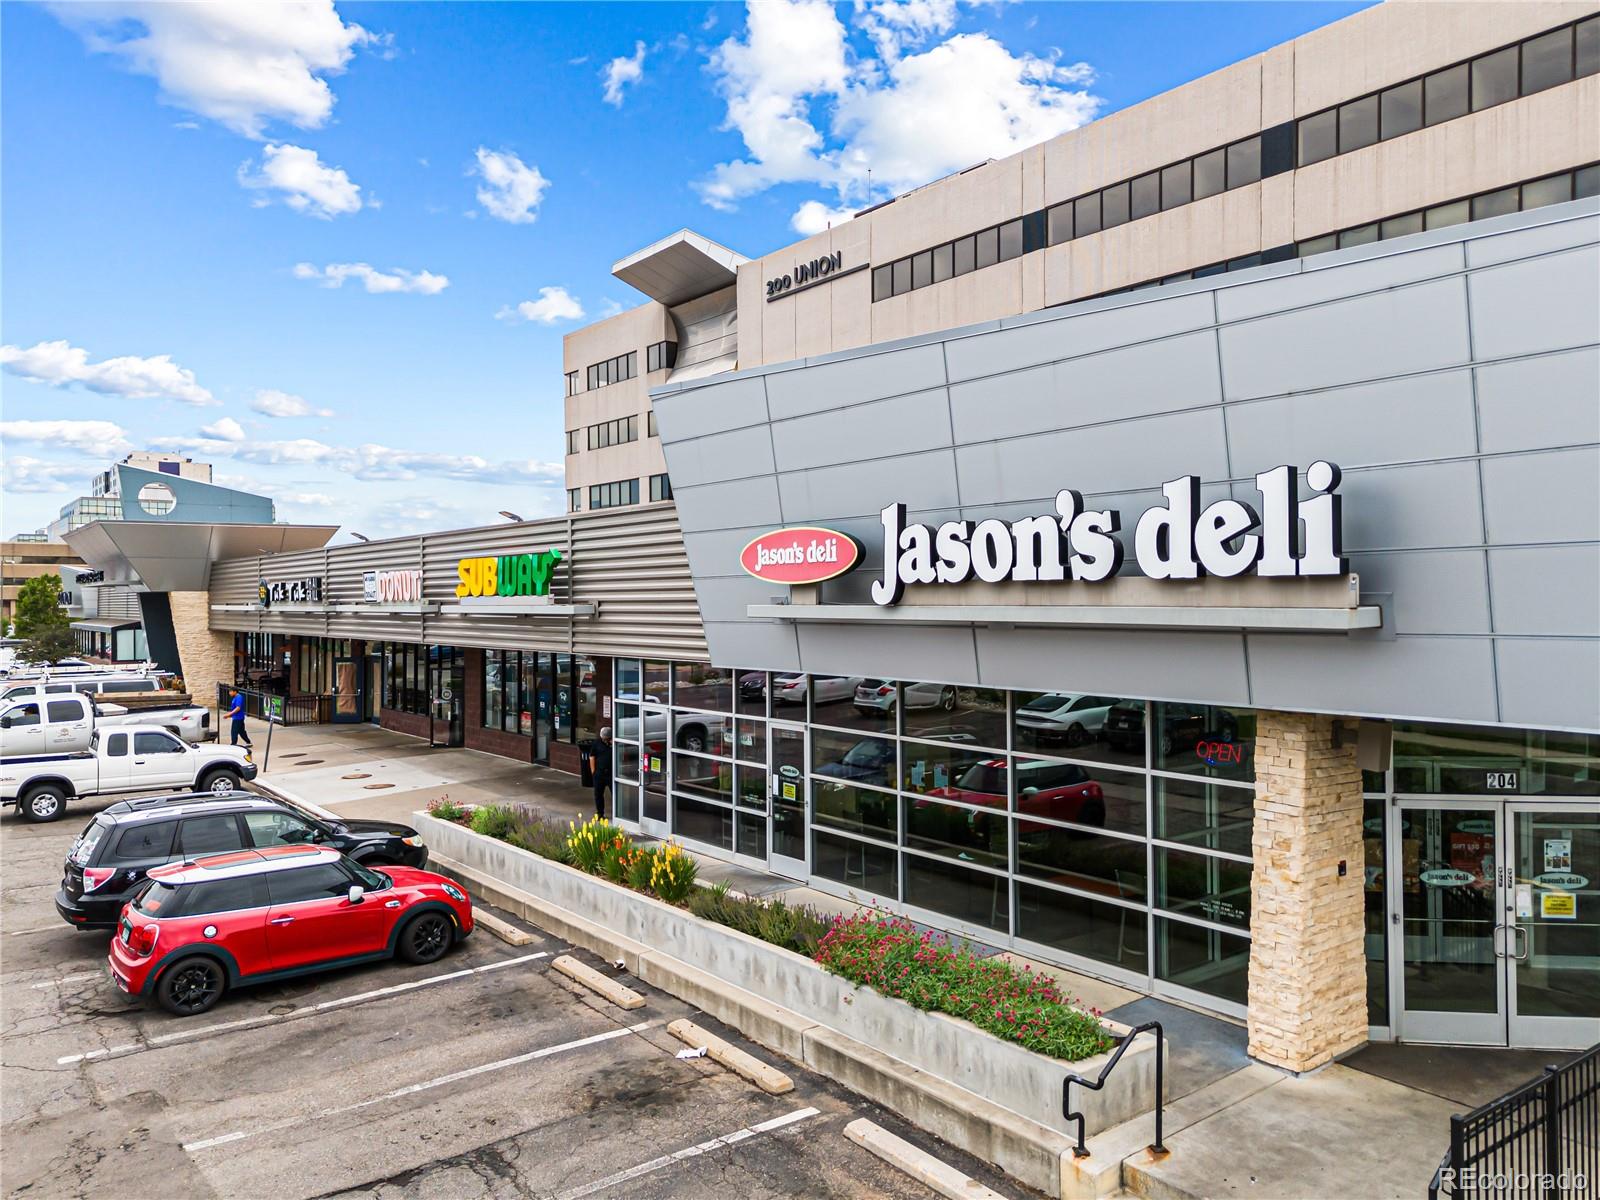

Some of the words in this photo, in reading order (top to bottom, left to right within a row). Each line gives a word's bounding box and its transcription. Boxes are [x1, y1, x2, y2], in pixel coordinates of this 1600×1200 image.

[766, 275, 792, 295] 200
[794, 250, 842, 283] UNION
[871, 489, 1121, 606] Jason's
[1135, 460, 1345, 579] deli
[455, 547, 562, 597] SUBWAY
[754, 543, 804, 572] Jason's
[806, 538, 838, 563] deli
[1196, 741, 1242, 763] OPEN
[1488, 773, 1515, 788] 204
